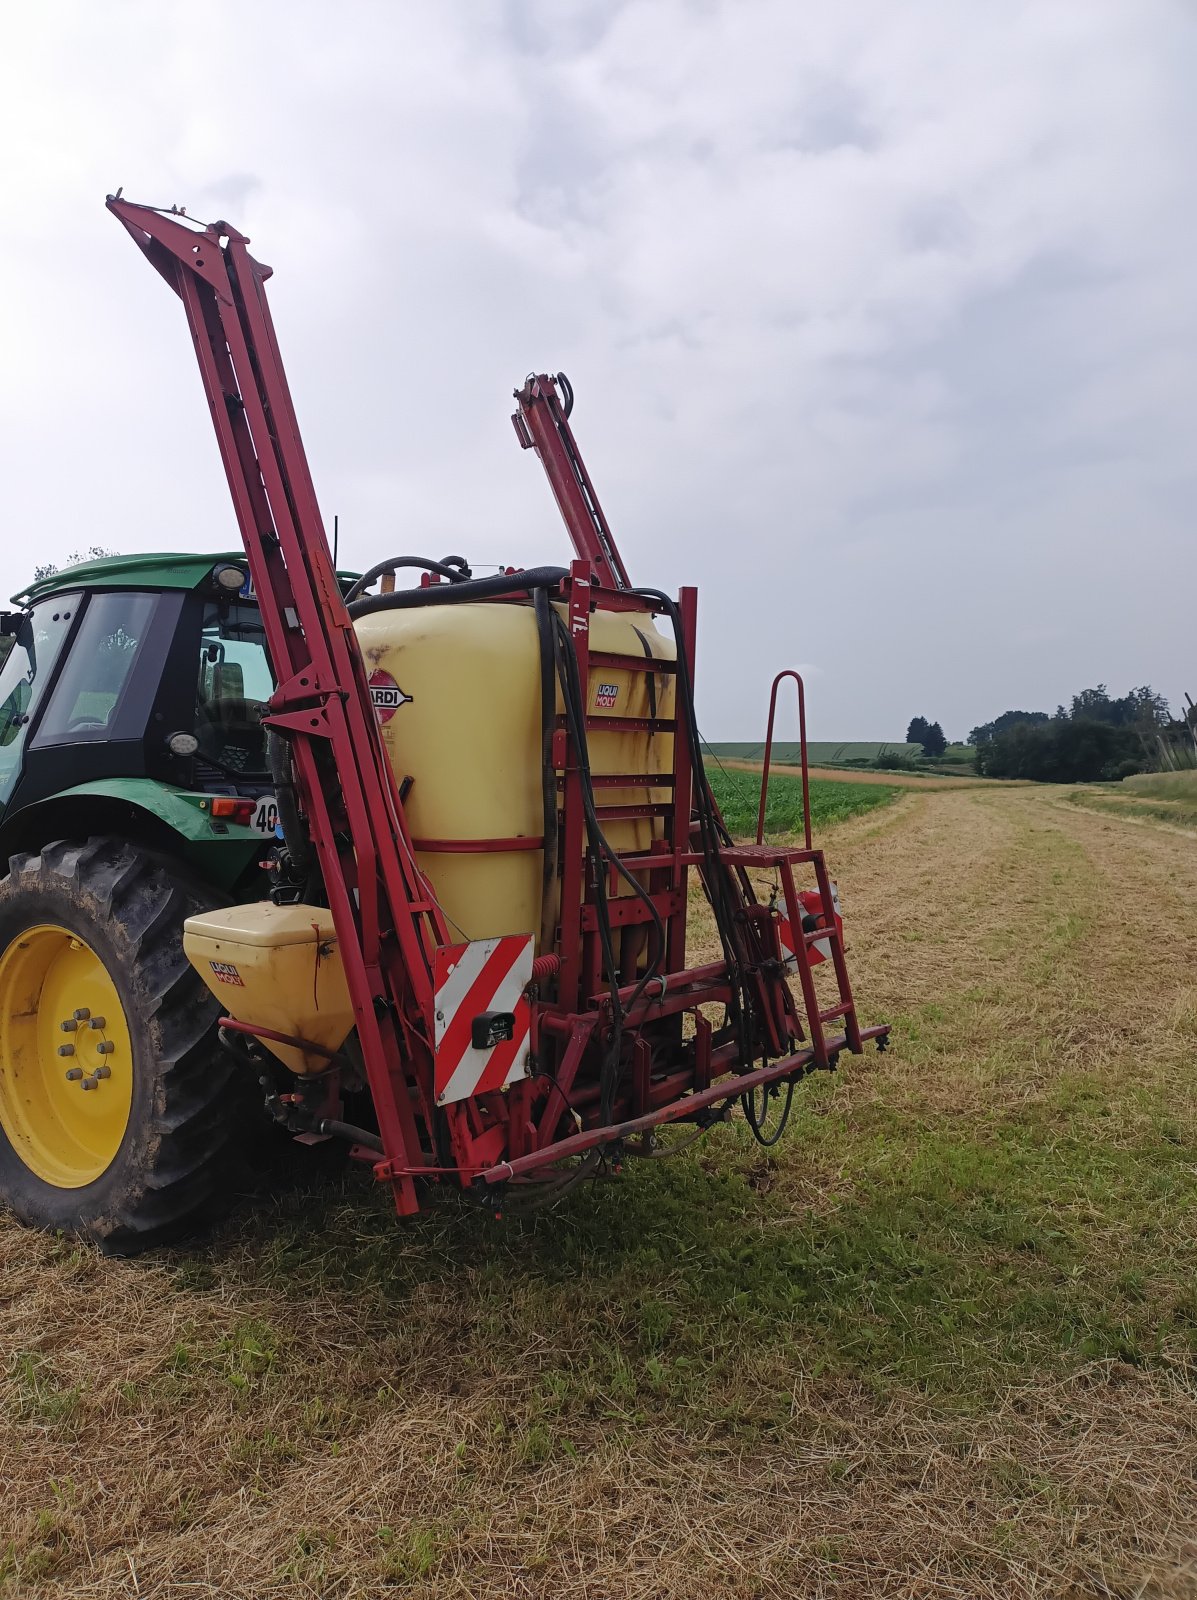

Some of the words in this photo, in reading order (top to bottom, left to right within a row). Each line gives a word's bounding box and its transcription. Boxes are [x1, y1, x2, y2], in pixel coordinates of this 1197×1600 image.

[598, 685, 617, 696] LIQUI
[596, 696, 616, 706] MOLY
[256, 803, 277, 832] 40
[210, 961, 238, 977] LIQUI
[215, 972, 243, 987] MOLY
